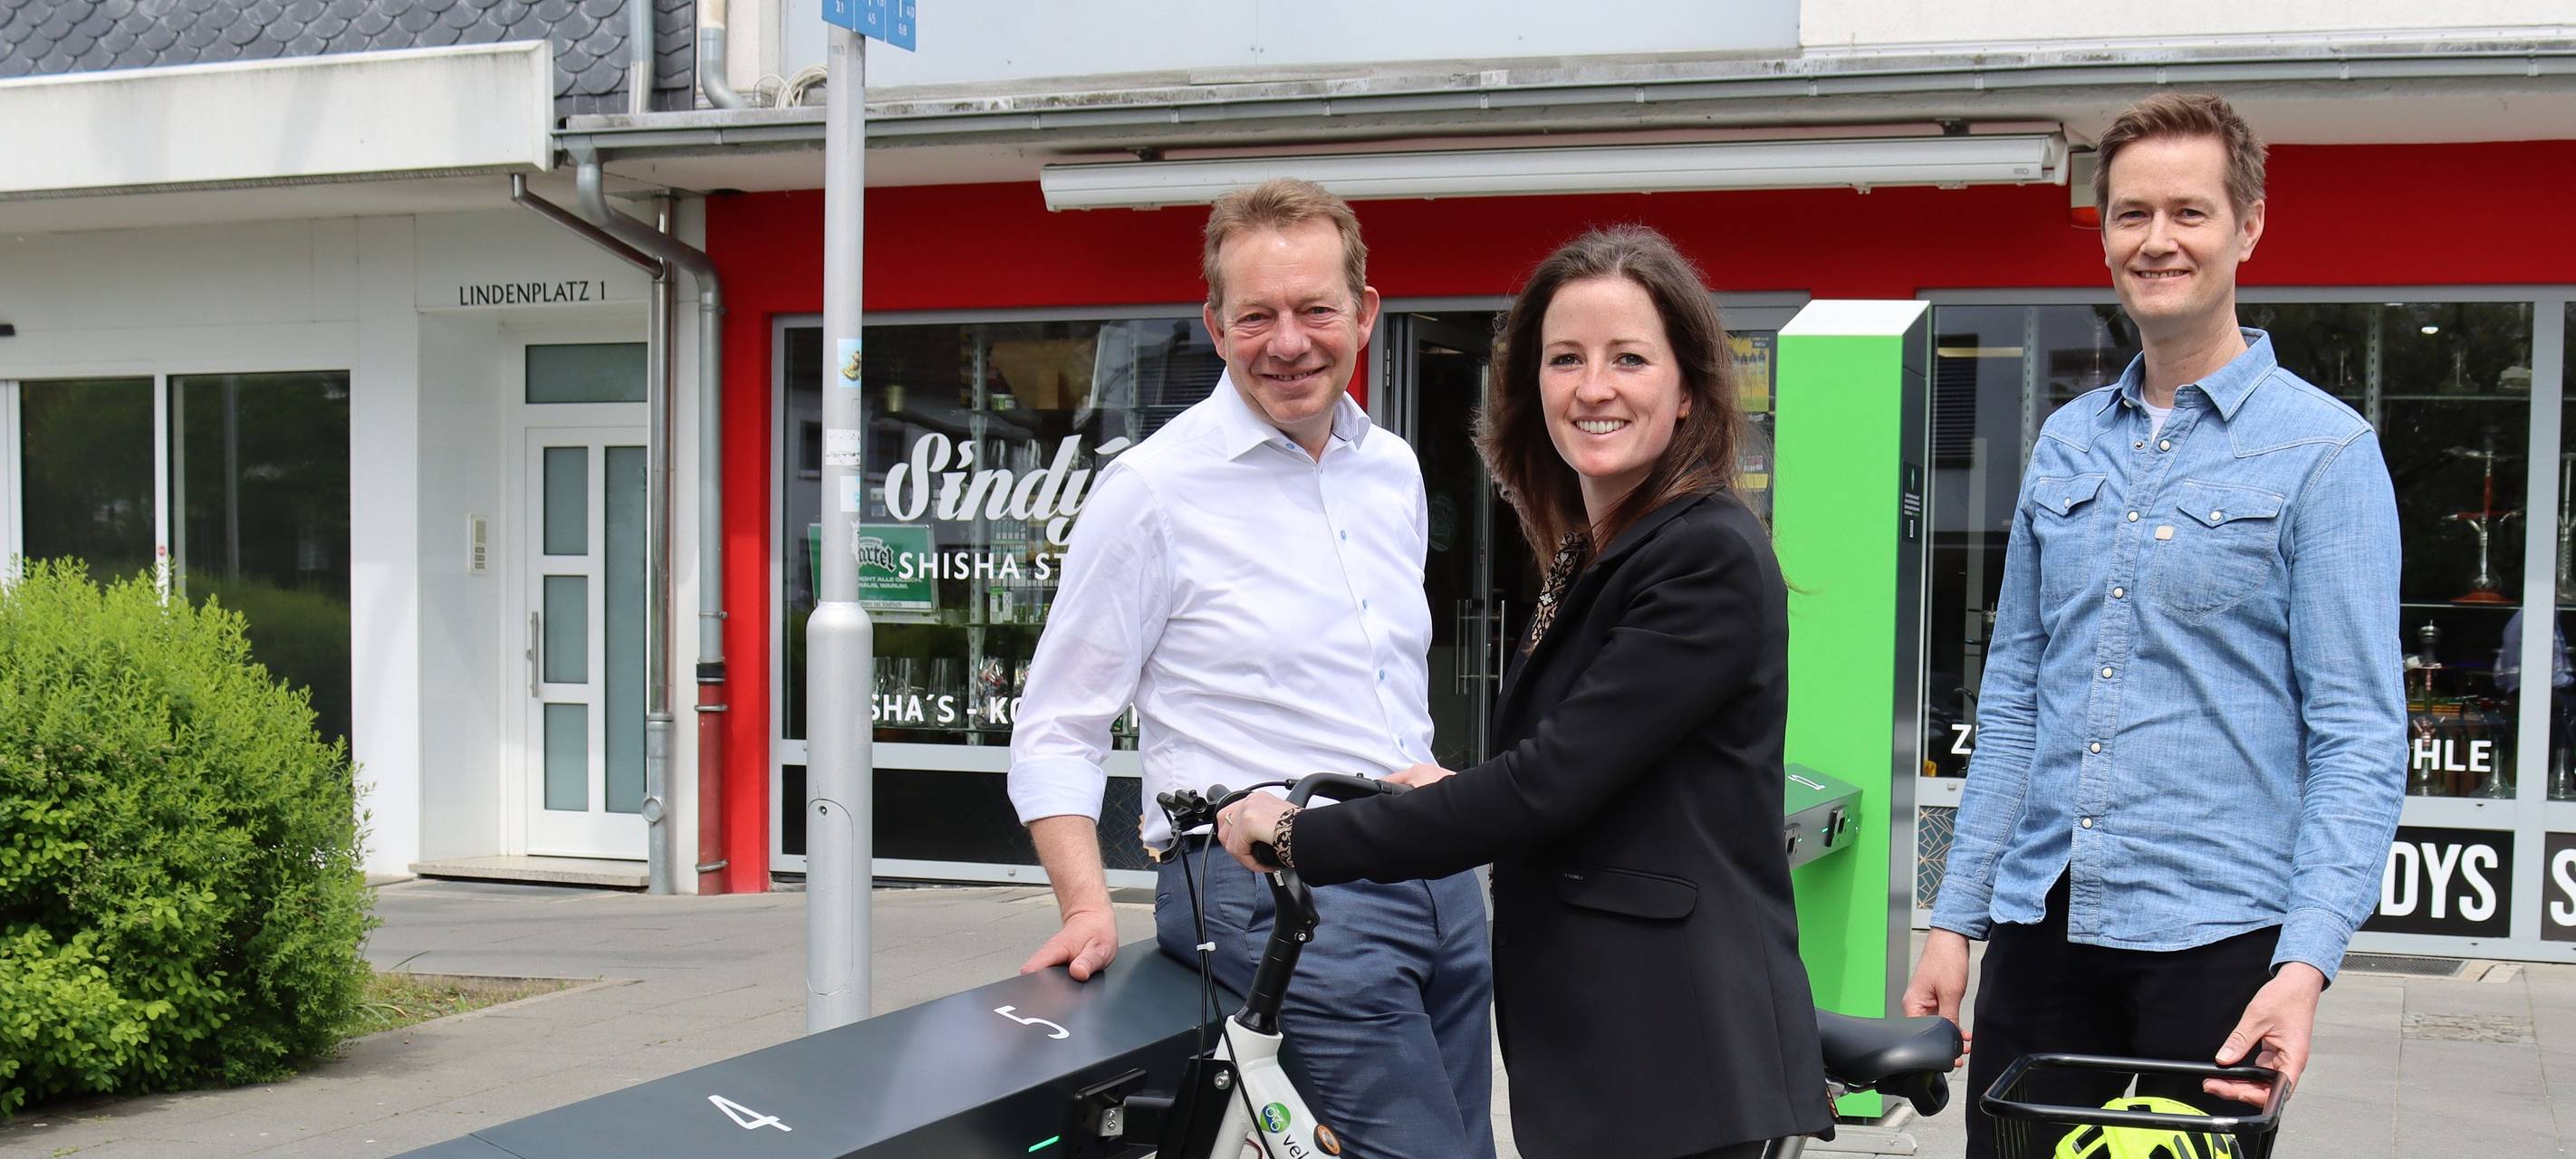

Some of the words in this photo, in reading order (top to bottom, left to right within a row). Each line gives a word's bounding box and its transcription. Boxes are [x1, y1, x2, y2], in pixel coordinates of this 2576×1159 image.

[459, 281, 590, 306] LINDENPLATZ
[601, 281, 606, 301] 1
[898, 551, 1021, 580] SHISHA
[1951, 723, 1978, 755] Z
[2412, 738, 2492, 772] HLE
[2371, 841, 2498, 922] DYS
[2550, 848, 2576, 927] S
[993, 1005, 1070, 1039] 5
[707, 1094, 793, 1132] 4
